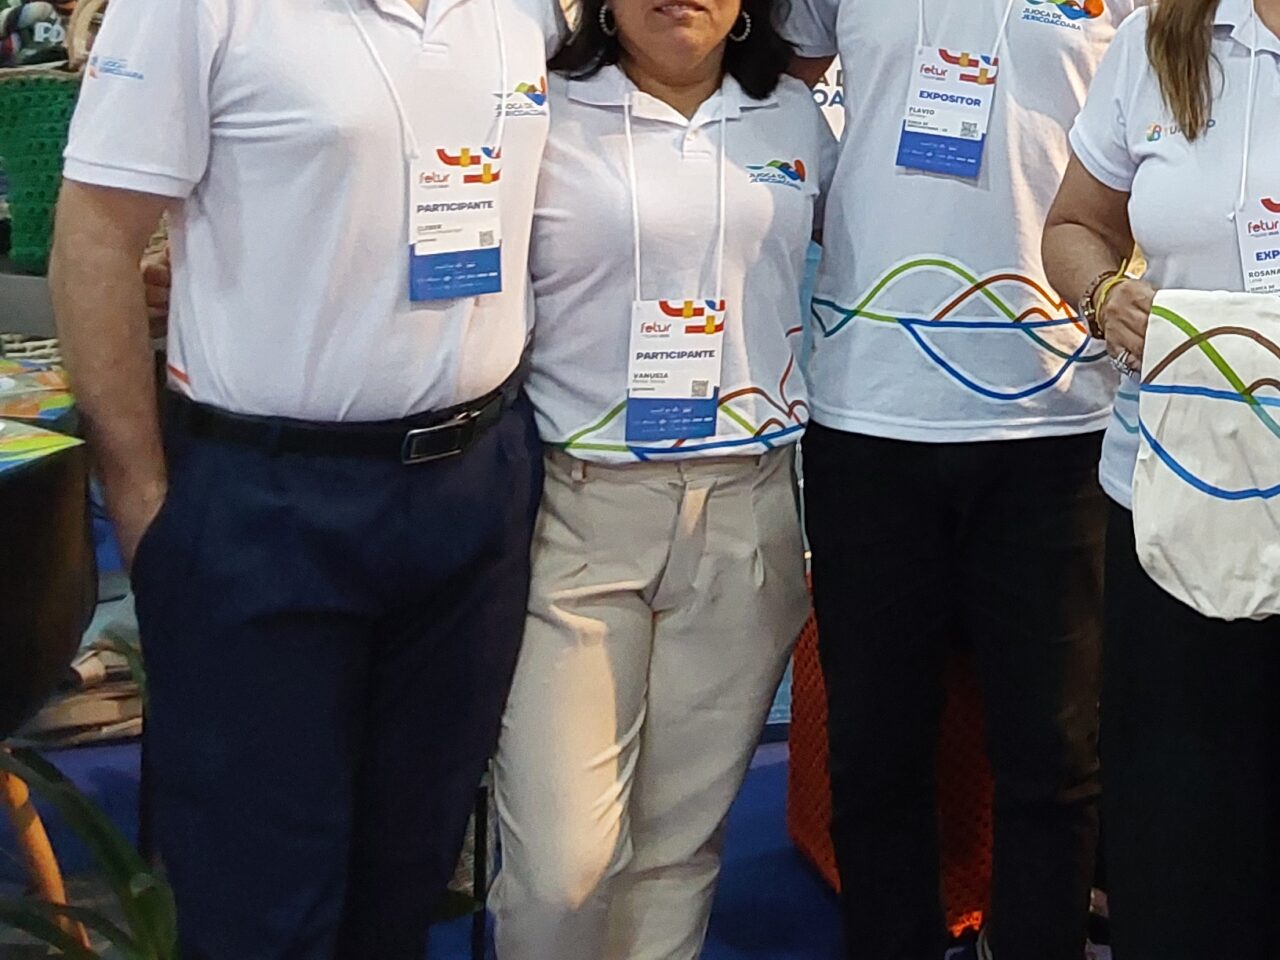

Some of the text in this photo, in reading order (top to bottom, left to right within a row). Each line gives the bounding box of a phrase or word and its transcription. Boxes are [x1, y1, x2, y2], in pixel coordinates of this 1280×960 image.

[919, 90, 981, 107] EXPOSITOR
[416, 200, 494, 213] PARTICIPANTE
[1247, 219, 1279, 234] fetur
[640, 321, 671, 334] fetur
[635, 349, 716, 360] PARTICIPANTE
